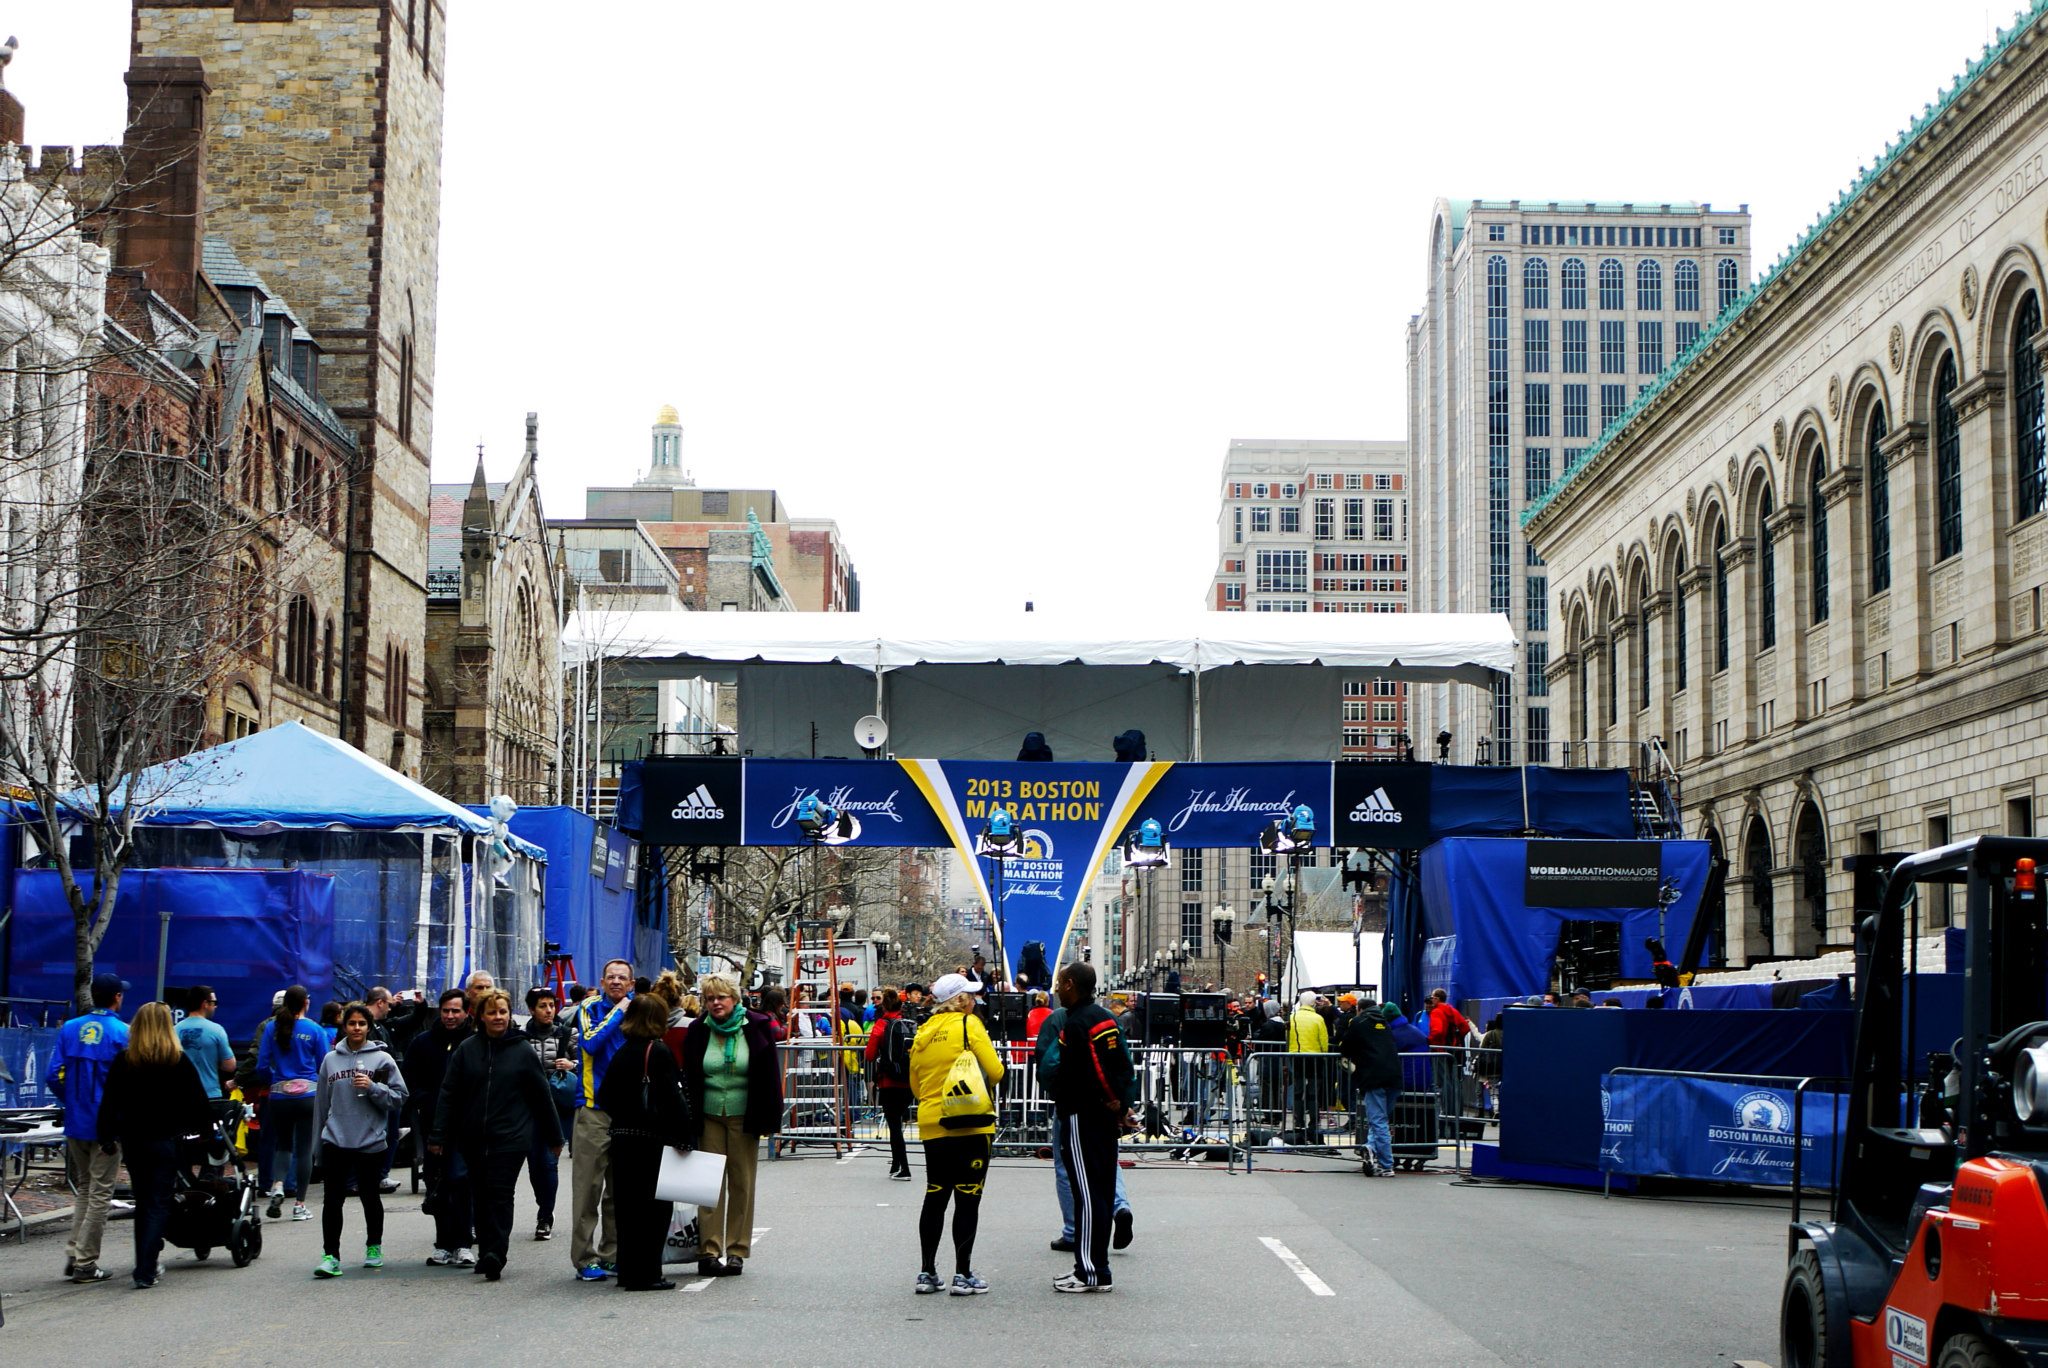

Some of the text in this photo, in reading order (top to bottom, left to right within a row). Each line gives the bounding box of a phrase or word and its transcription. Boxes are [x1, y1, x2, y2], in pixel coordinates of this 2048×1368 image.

[1745, 393, 1763, 424] THE
[1774, 354, 1808, 402] PEOPLE
[1820, 334, 1831, 365] AS
[1842, 306, 1865, 343] THE
[1877, 241, 1944, 310] SAFEGUARD
[1959, 209, 1978, 246] OF
[1994, 153, 2046, 215] ORDER
[966, 778, 1100, 799] 2013 BOSTON
[671, 805, 725, 820] adidas
[966, 799, 1101, 821] MARATHON
[1168, 788, 1222, 832] John
[1349, 809, 1403, 823] adidas
[1003, 869, 1064, 880] MARATHON
[1023, 862, 1063, 871] BOSTON
[999, 882, 1026, 902] John
[1735, 1101, 1745, 1126] BOSTON
[1743, 1093, 1771, 1104] ATHLETIC
[1708, 1128, 1813, 1148] BOSTON MARATHN
[1712, 1146, 1797, 1176] John Hancoc
[667, 1235, 699, 1248] adida
[1903, 1320, 1924, 1341] United
[1903, 1336, 1926, 1357] Rentals
